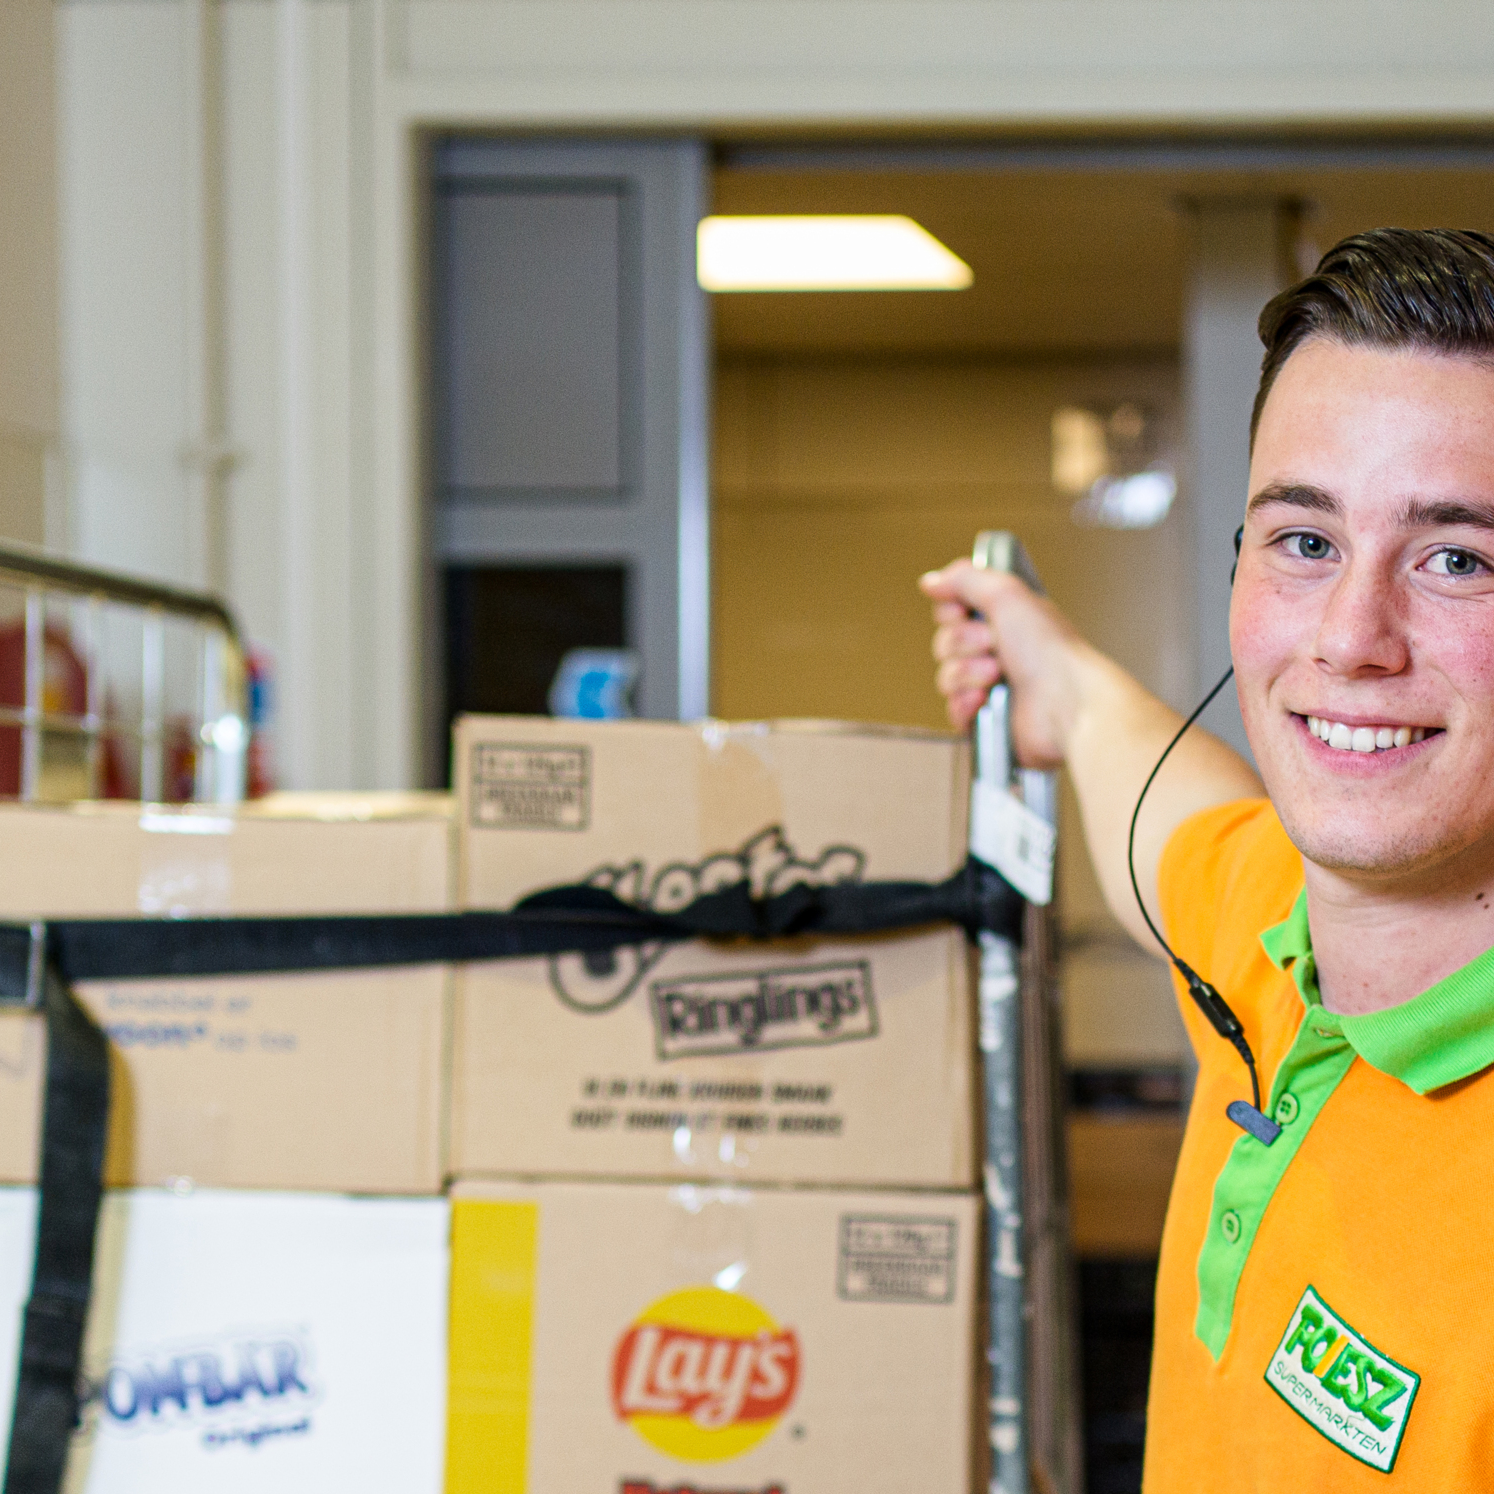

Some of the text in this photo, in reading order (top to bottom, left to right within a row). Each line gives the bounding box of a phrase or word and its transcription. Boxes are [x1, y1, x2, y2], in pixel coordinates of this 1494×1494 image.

[662, 976, 862, 1046] Ringlings
[620, 1324, 794, 1430] Lay's
[1273, 1360, 1388, 1455] SUPERMARKTEN
[1284, 1303, 1408, 1432] POIESZ
